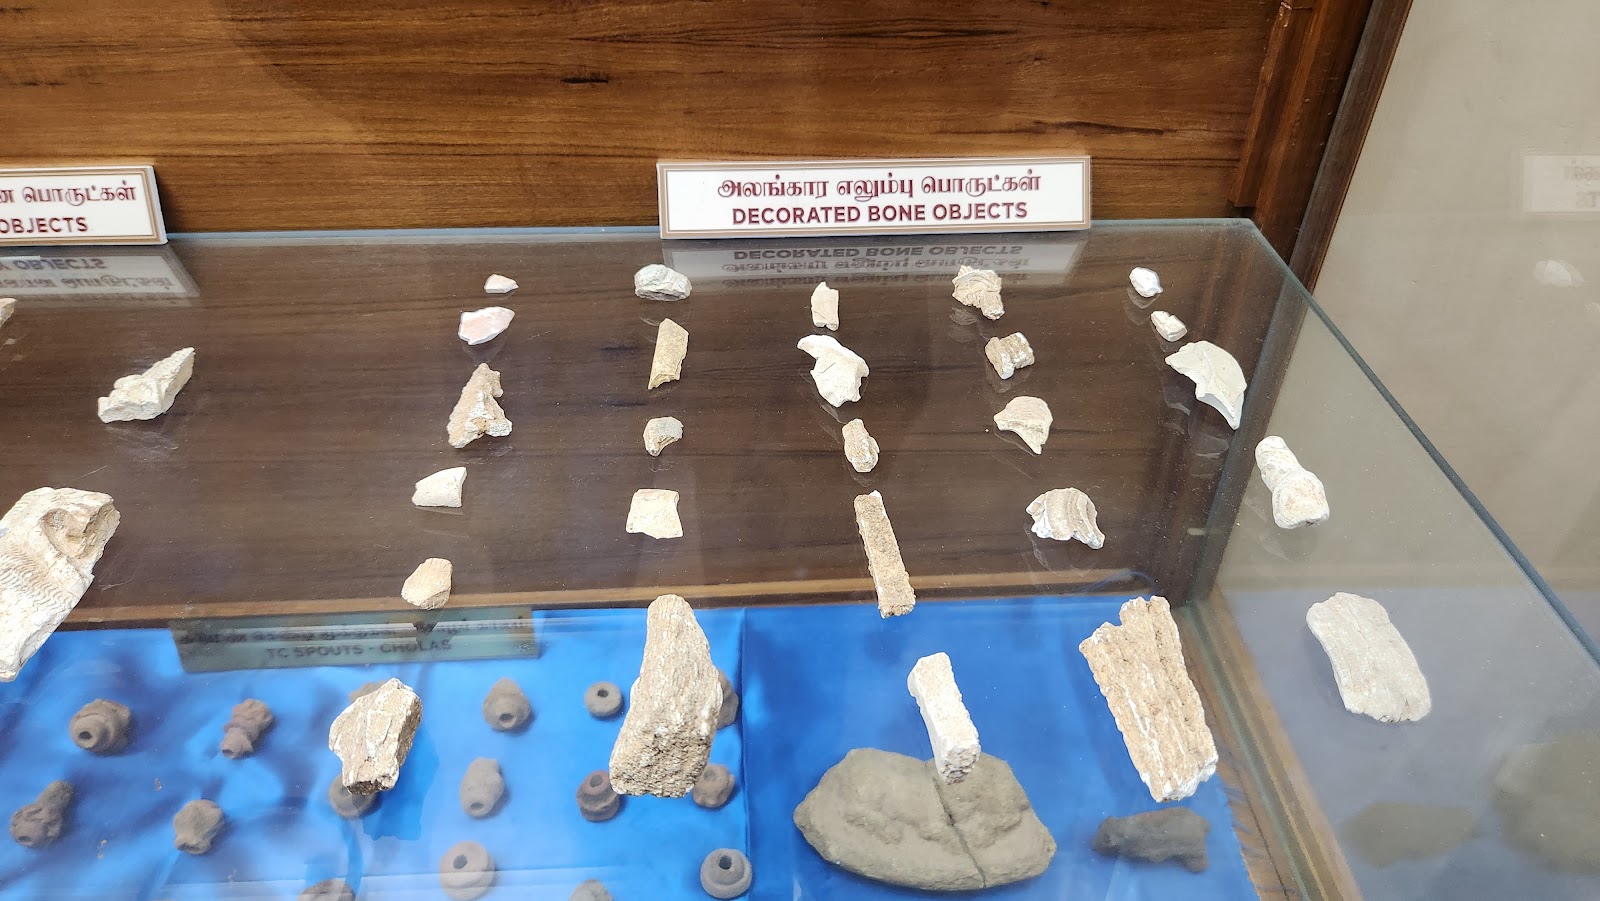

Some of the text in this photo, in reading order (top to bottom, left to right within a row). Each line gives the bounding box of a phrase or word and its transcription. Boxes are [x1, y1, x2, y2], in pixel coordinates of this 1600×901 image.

[22, 180, 137, 207] பொருட்கள்
[717, 169, 1041, 202] அலங்கார எலும்பு பொருட்கள்
[732, 202, 1028, 225] DECORATED BONE OBJECTS
[0, 217, 88, 234] OBJECTS
[266, 647, 289, 659] TC
[297, 644, 364, 657] SPOUTS
